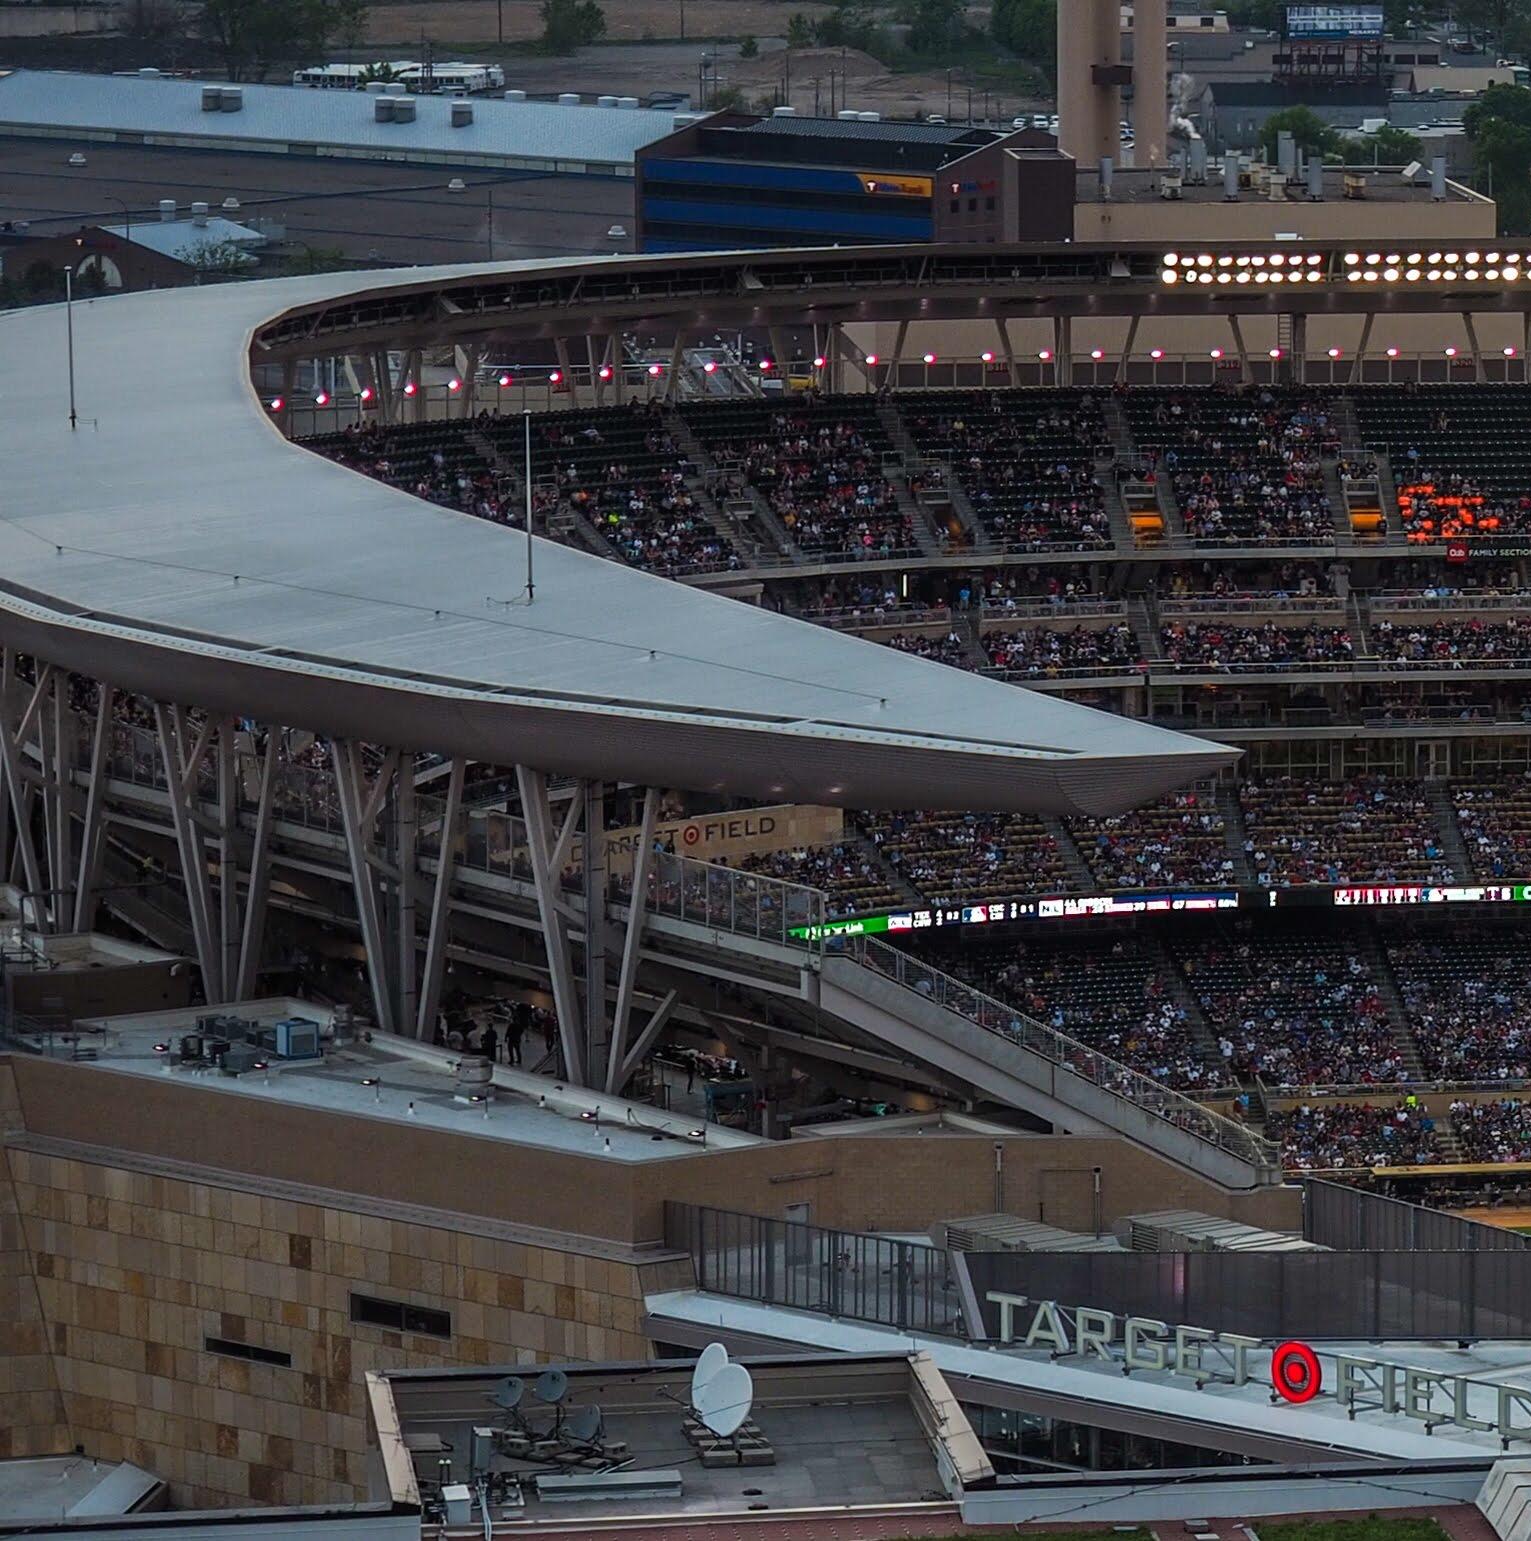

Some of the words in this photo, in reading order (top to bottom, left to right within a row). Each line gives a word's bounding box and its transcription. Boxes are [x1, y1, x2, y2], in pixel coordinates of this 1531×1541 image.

[1468, 548, 1498, 557] FAMILY
[704, 816, 776, 842] FIELD
[986, 1290, 1263, 1387] TARGET
